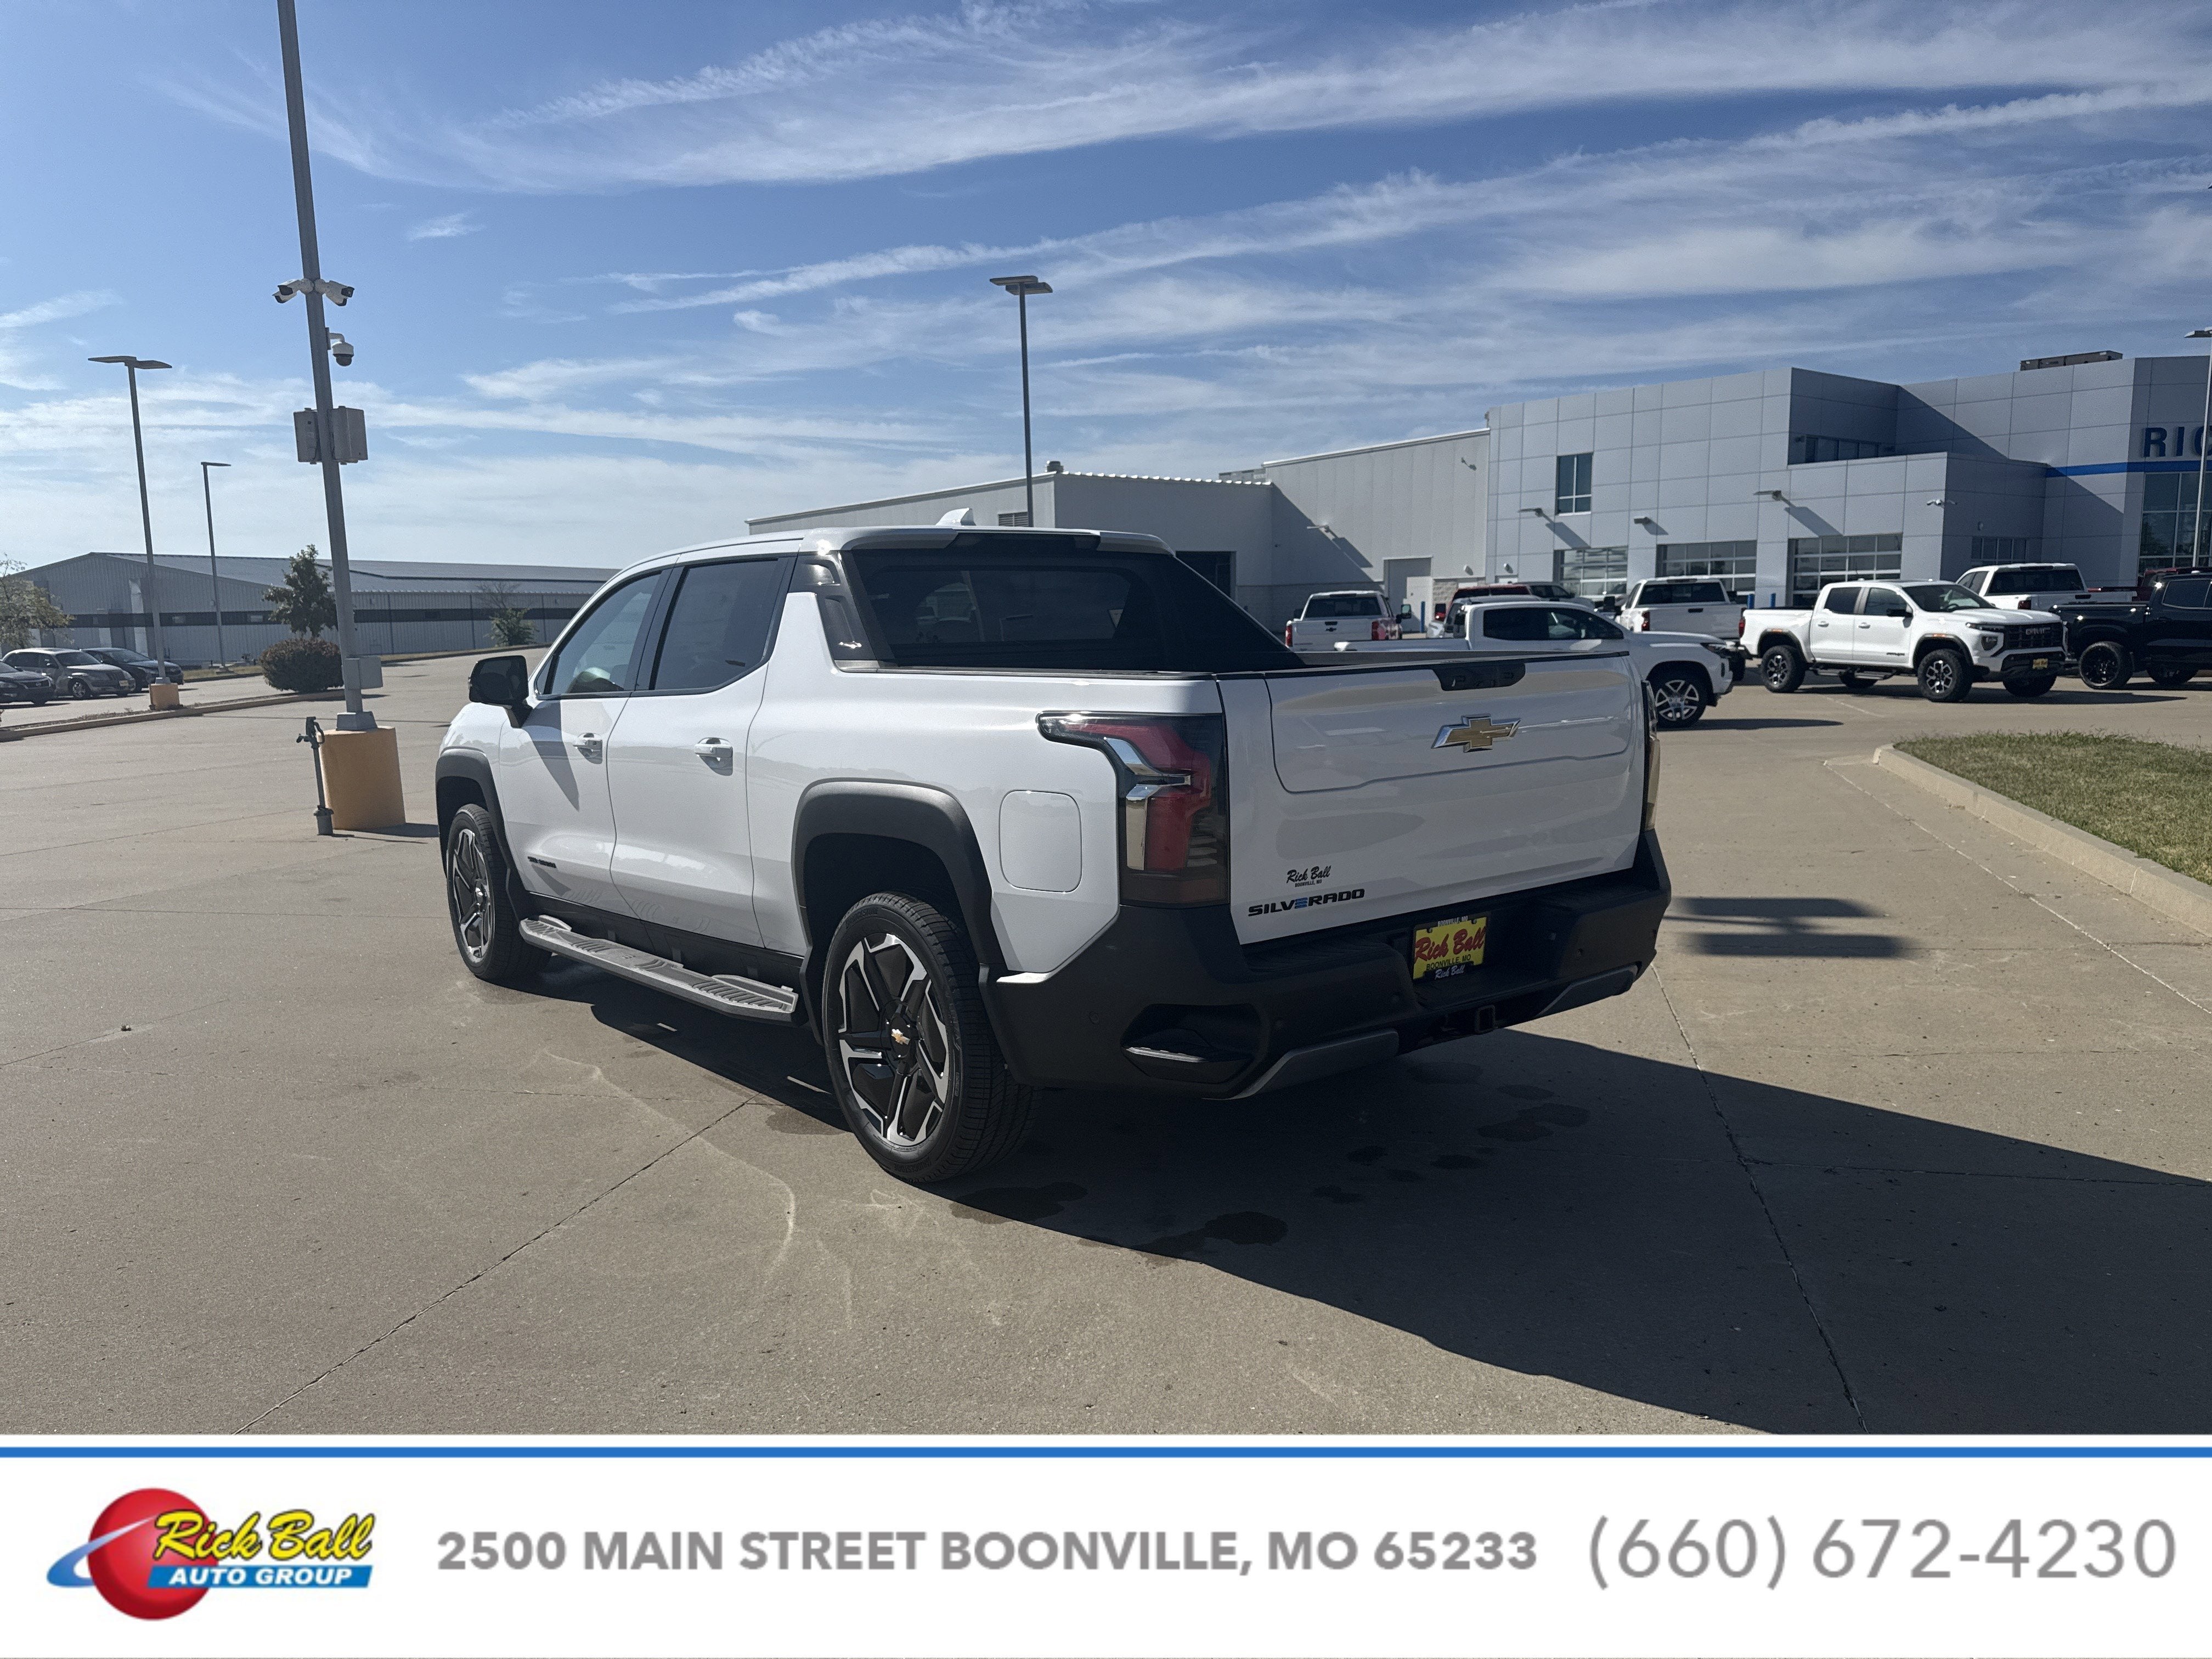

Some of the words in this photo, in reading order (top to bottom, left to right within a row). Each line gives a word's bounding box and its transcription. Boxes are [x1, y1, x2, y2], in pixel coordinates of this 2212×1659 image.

[1286, 868, 1308, 883] Rick
[1311, 865, 1331, 878] Ball
[1248, 888, 1365, 916] SILVERADO
[1414, 933, 1449, 963] Rick
[1453, 927, 1486, 955] Ball
[1426, 957, 1460, 969] BOONVILLE,
[1462, 954, 1471, 963] MO
[1435, 968, 1450, 980] Rick
[1451, 964, 1465, 975] Ball
